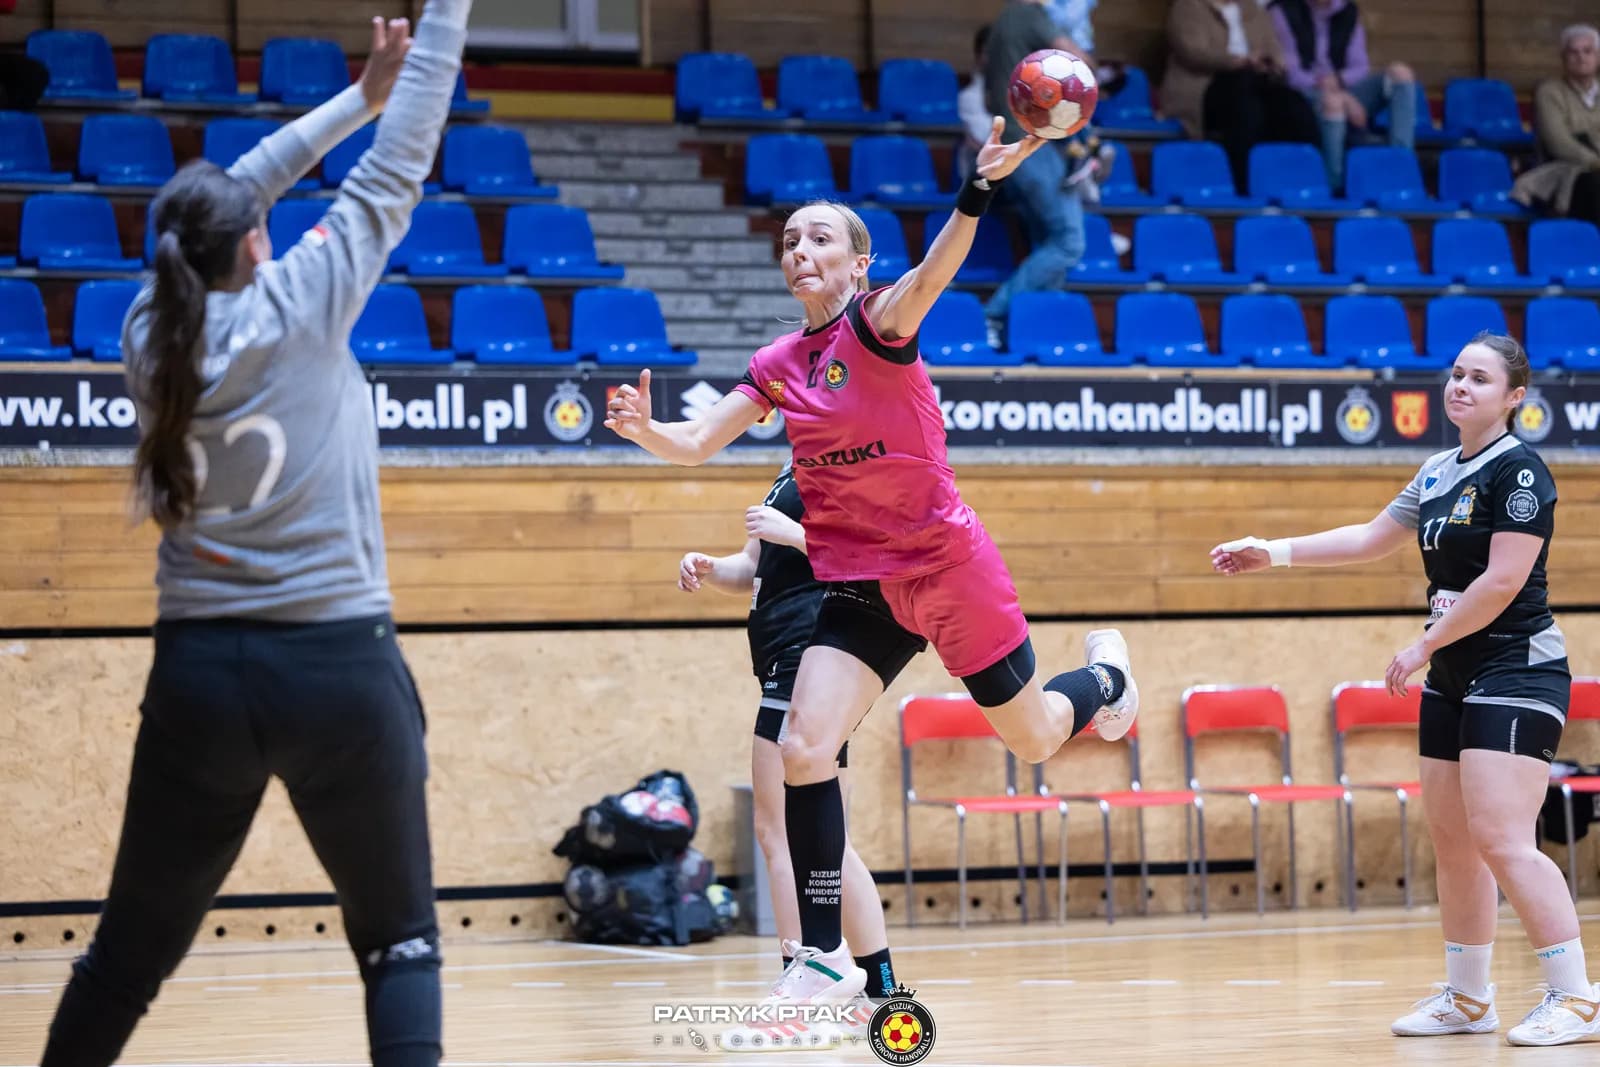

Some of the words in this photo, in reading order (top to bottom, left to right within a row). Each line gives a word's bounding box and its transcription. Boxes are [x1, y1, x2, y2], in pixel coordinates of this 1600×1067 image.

[796, 439, 887, 468] SUZUKI
[1422, 516, 1449, 550] 17
[804, 888, 842, 896] HANDBAL
[812, 896, 839, 905] KIELCE
